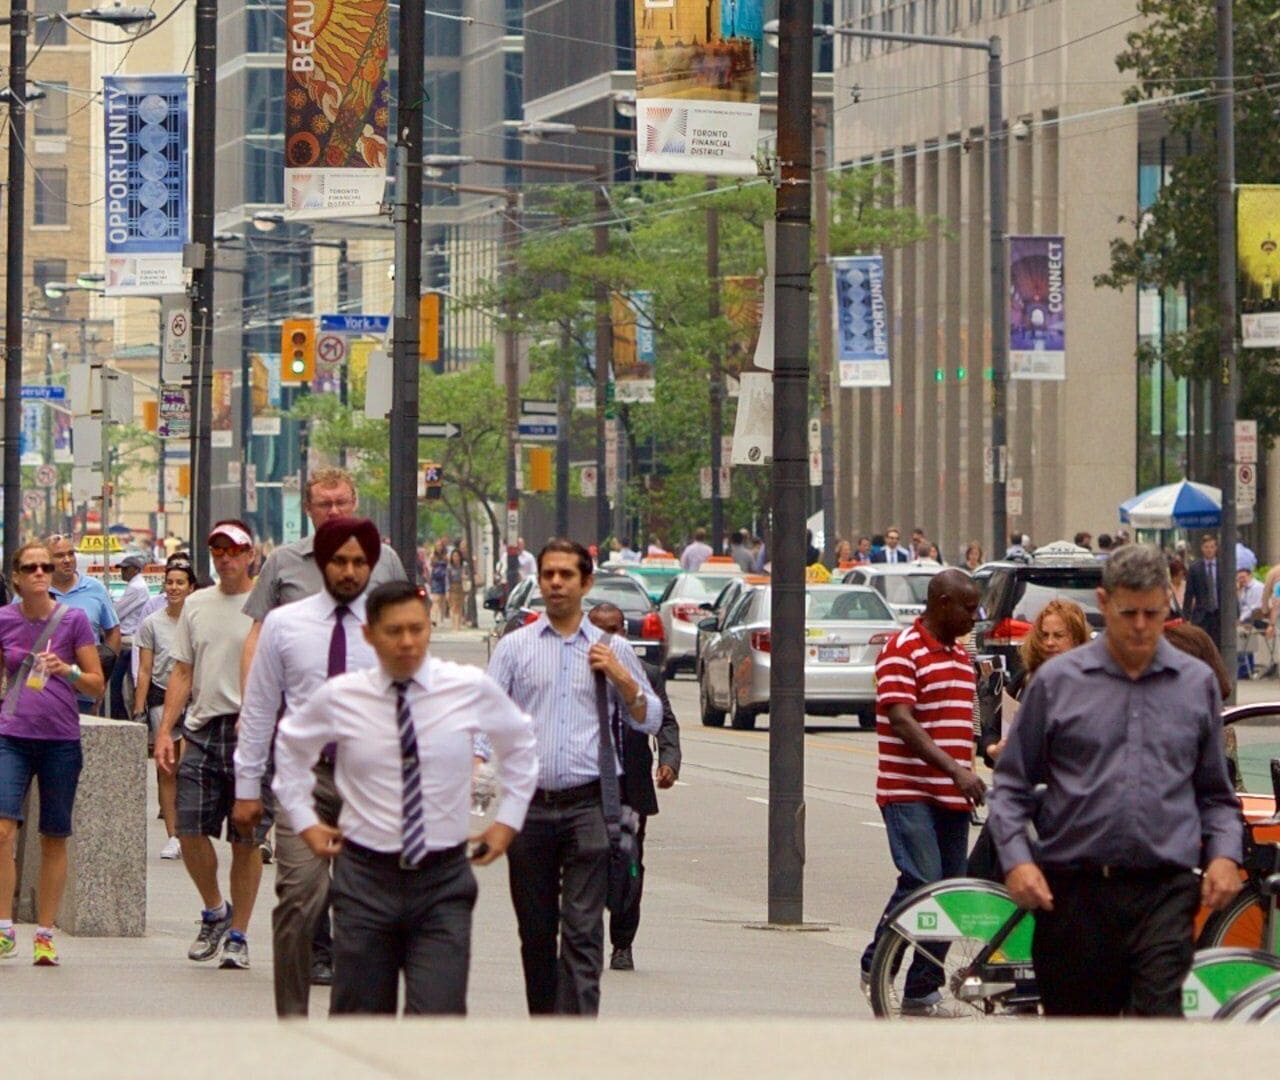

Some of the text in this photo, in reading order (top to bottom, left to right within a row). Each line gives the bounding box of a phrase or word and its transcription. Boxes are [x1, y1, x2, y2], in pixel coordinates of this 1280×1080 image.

[692, 129, 728, 138] TORONTO
[691, 139, 731, 148] FINANCIAL
[690, 148, 725, 156] DISTRICT
[107, 87, 128, 245] OPPORTUNITY
[1048, 241, 1062, 313] CONNECT
[869, 263, 887, 355] OPPORTUNITY
[345, 317, 369, 328] York
[20, 387, 51, 398] versity
[920, 915, 936, 927] TD
